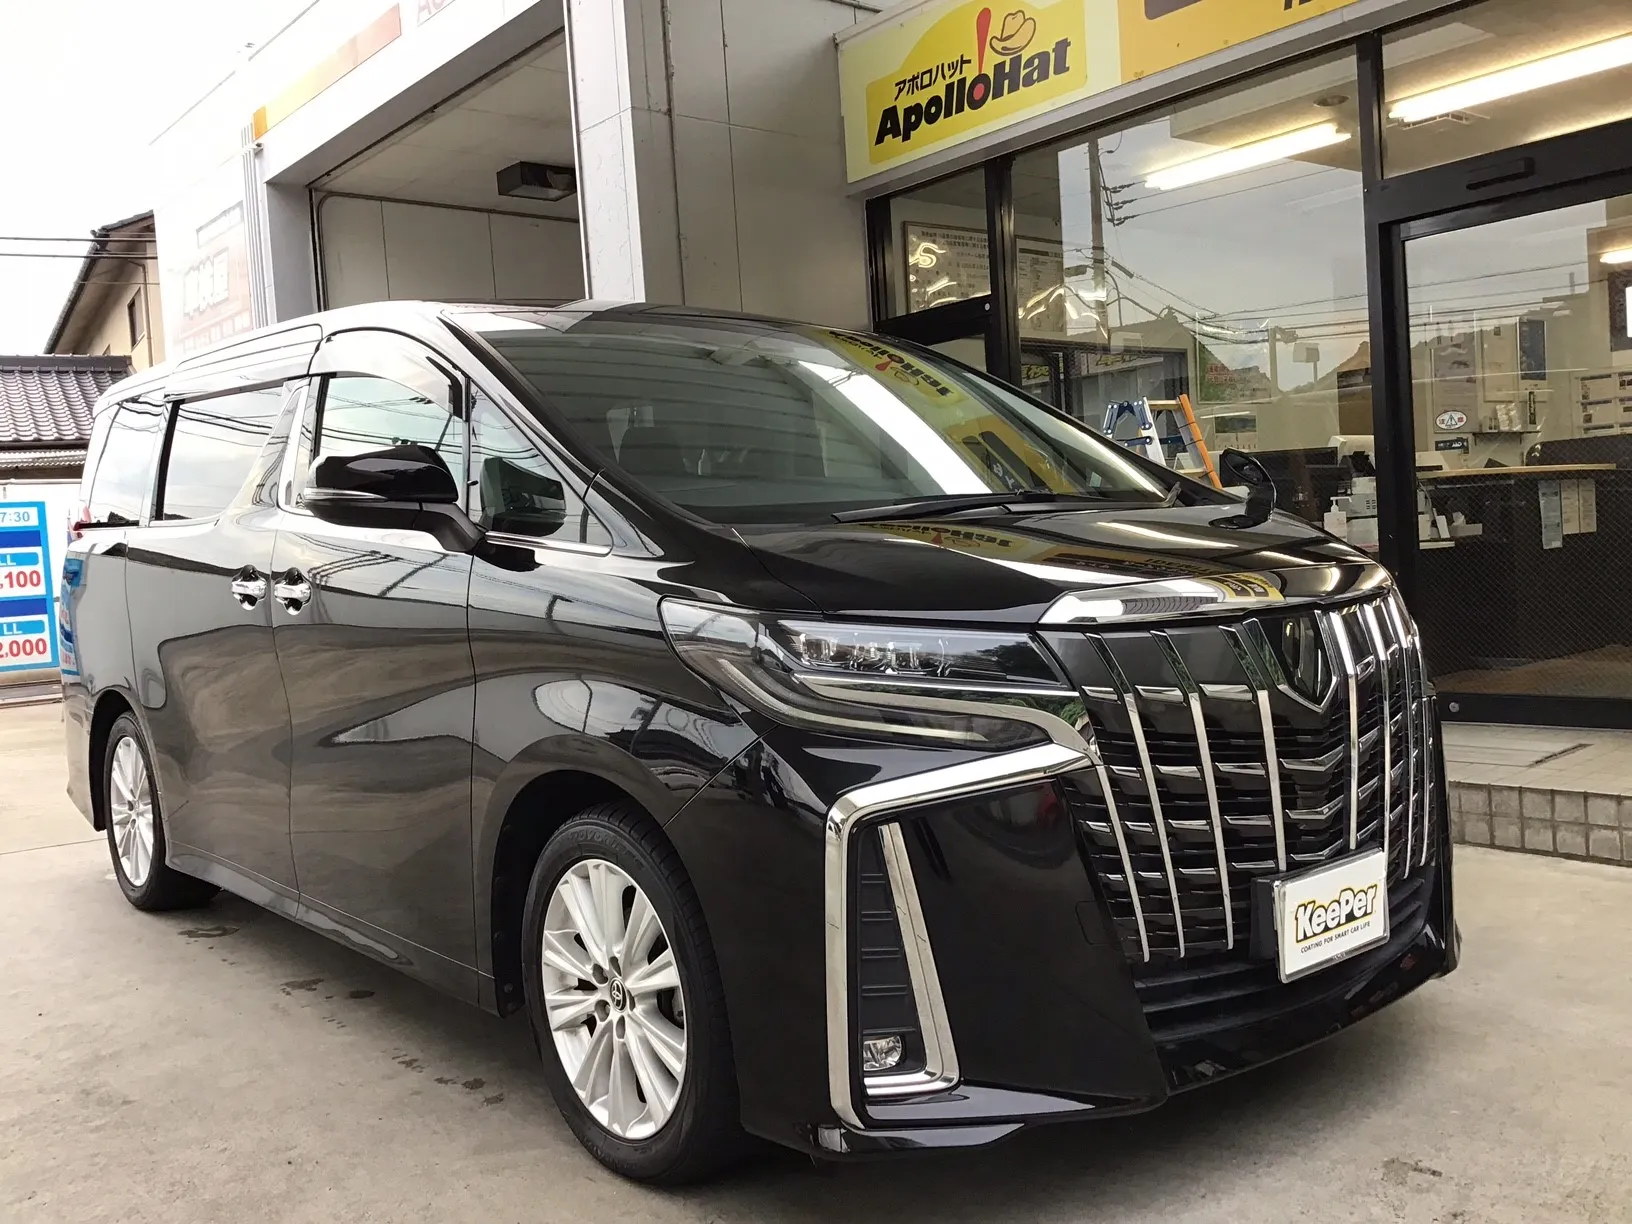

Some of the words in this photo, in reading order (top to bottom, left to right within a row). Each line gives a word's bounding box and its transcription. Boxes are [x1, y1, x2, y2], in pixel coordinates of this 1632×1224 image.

[874, 37, 1071, 146] ApolloHat
[894, 54, 972, 101] アポロハット
[3, 623, 23, 635] LL
[1295, 884, 1377, 943] KeePer
[1300, 940, 1323, 953] COATING
[1324, 936, 1334, 945] FOR
[1335, 929, 1350, 940] SMART
[1350, 925, 1360, 934] CAR
[1360, 920, 1371, 930] LIFE
